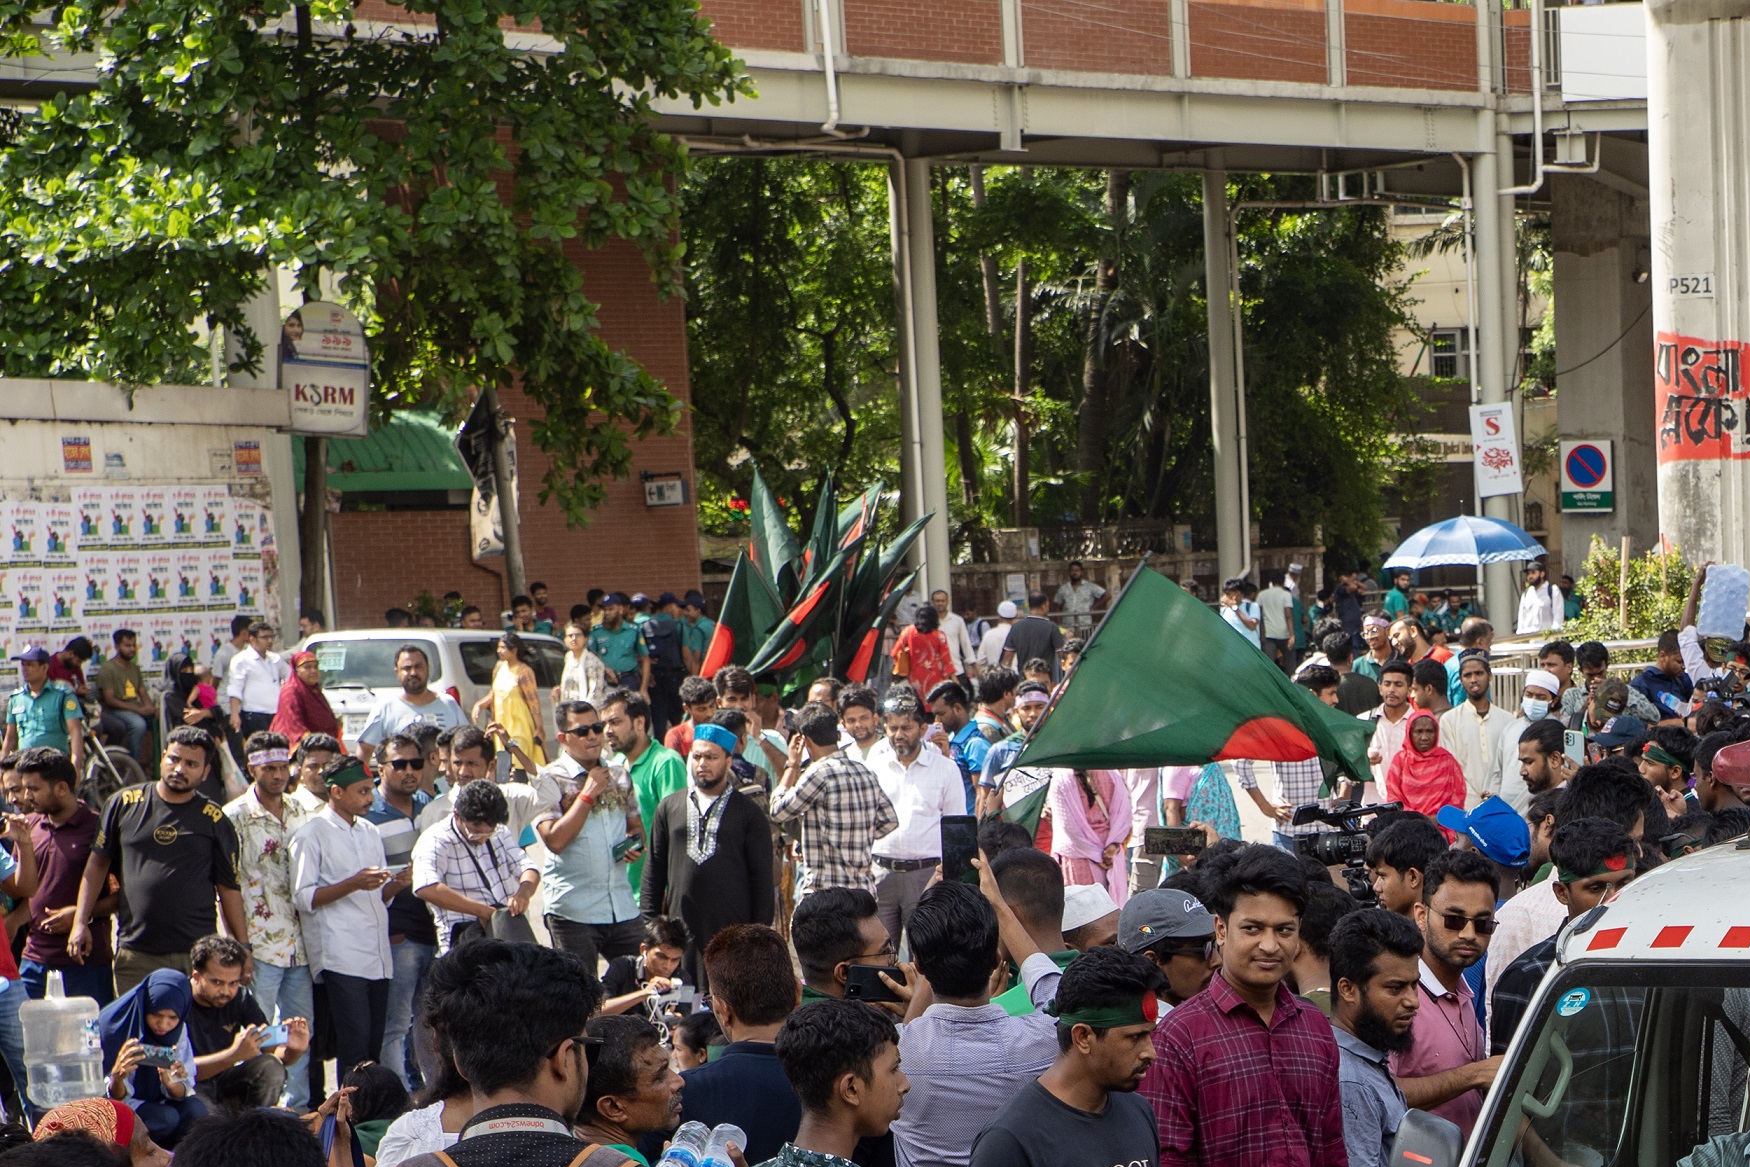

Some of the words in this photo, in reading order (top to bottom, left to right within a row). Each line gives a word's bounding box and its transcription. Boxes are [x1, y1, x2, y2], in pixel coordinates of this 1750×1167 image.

[1669, 277, 1712, 294] P521
[295, 383, 354, 406] KSRM
[1486, 416, 1500, 436] S
[488, 1120, 545, 1130] bdnews24.com
